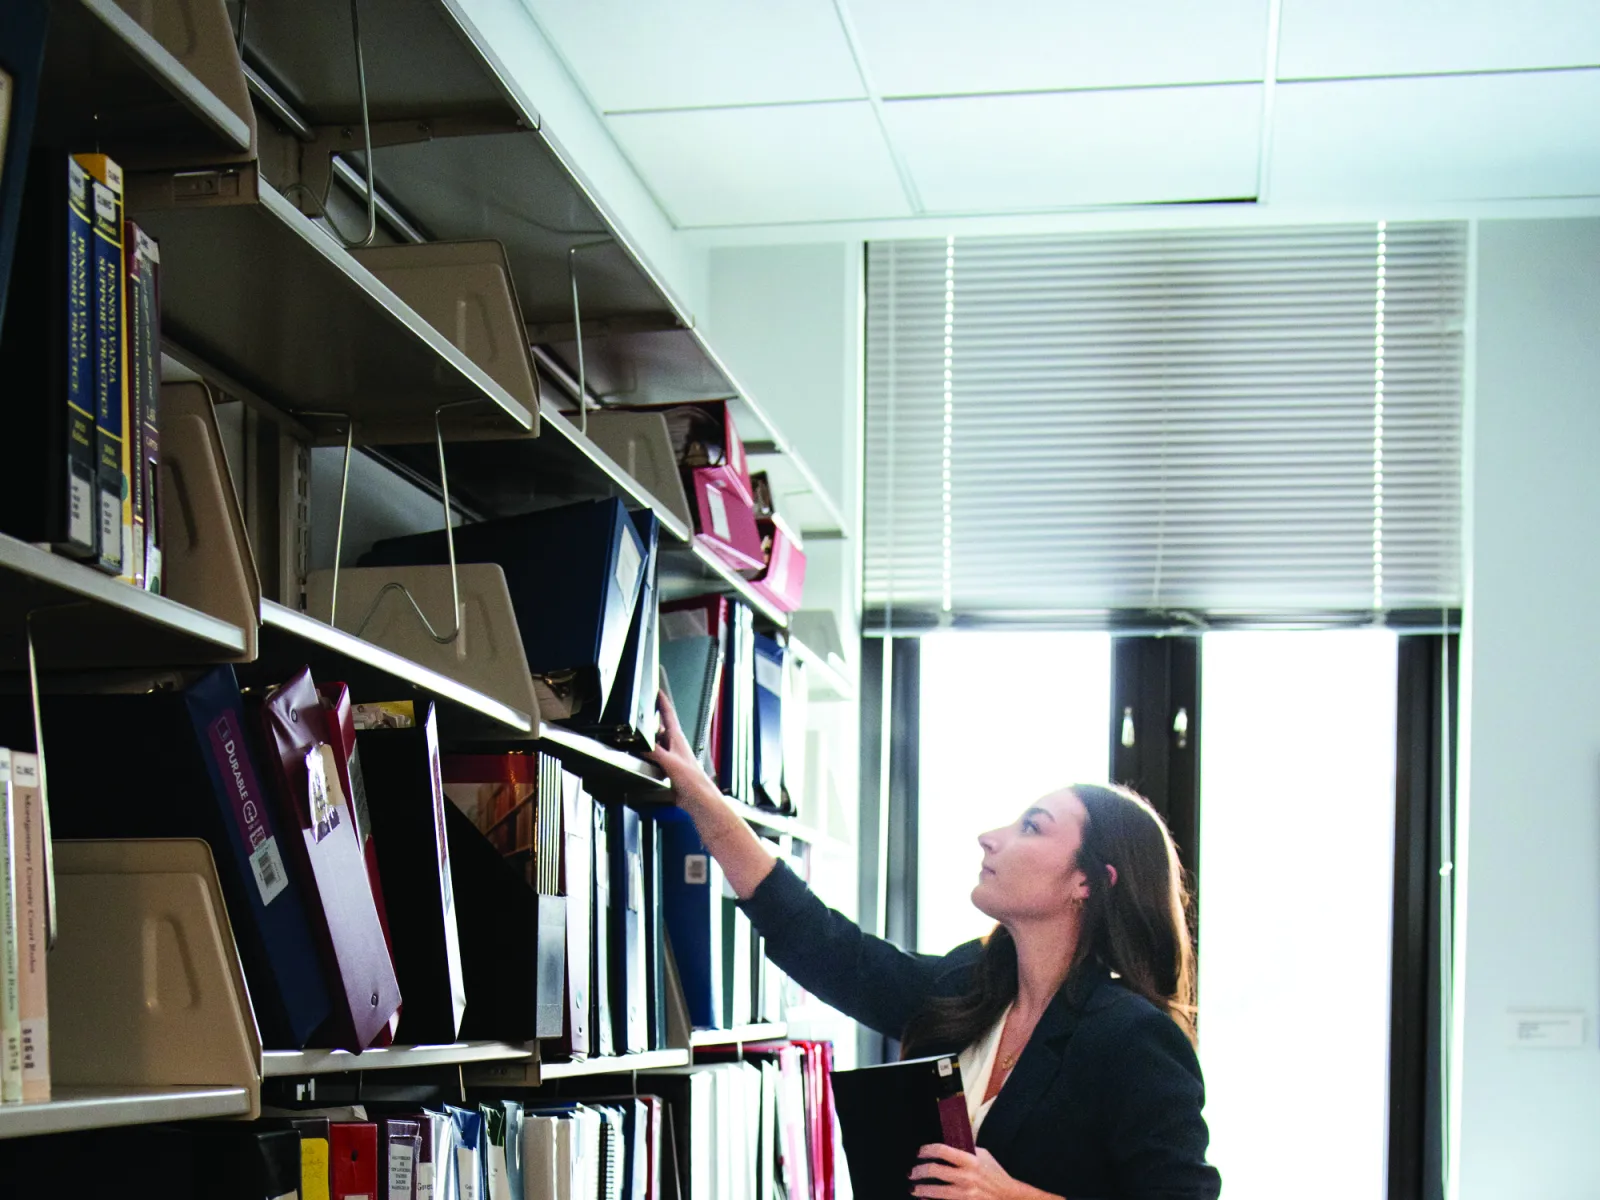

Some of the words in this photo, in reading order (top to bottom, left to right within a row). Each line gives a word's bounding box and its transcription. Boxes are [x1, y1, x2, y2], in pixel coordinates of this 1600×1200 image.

[71, 230, 79, 308] SUPPORT
[78, 236, 88, 360] PENNSYLVANIA
[99, 255, 108, 333] SUPPORT
[72, 312, 80, 394] PRACTICE
[107, 262, 117, 384] PENNSYLVANIA
[101, 338, 109, 419] PRACTICE
[224, 740, 249, 801] DURABLE
[26, 866, 35, 906] County
[27, 909, 36, 942] Court
